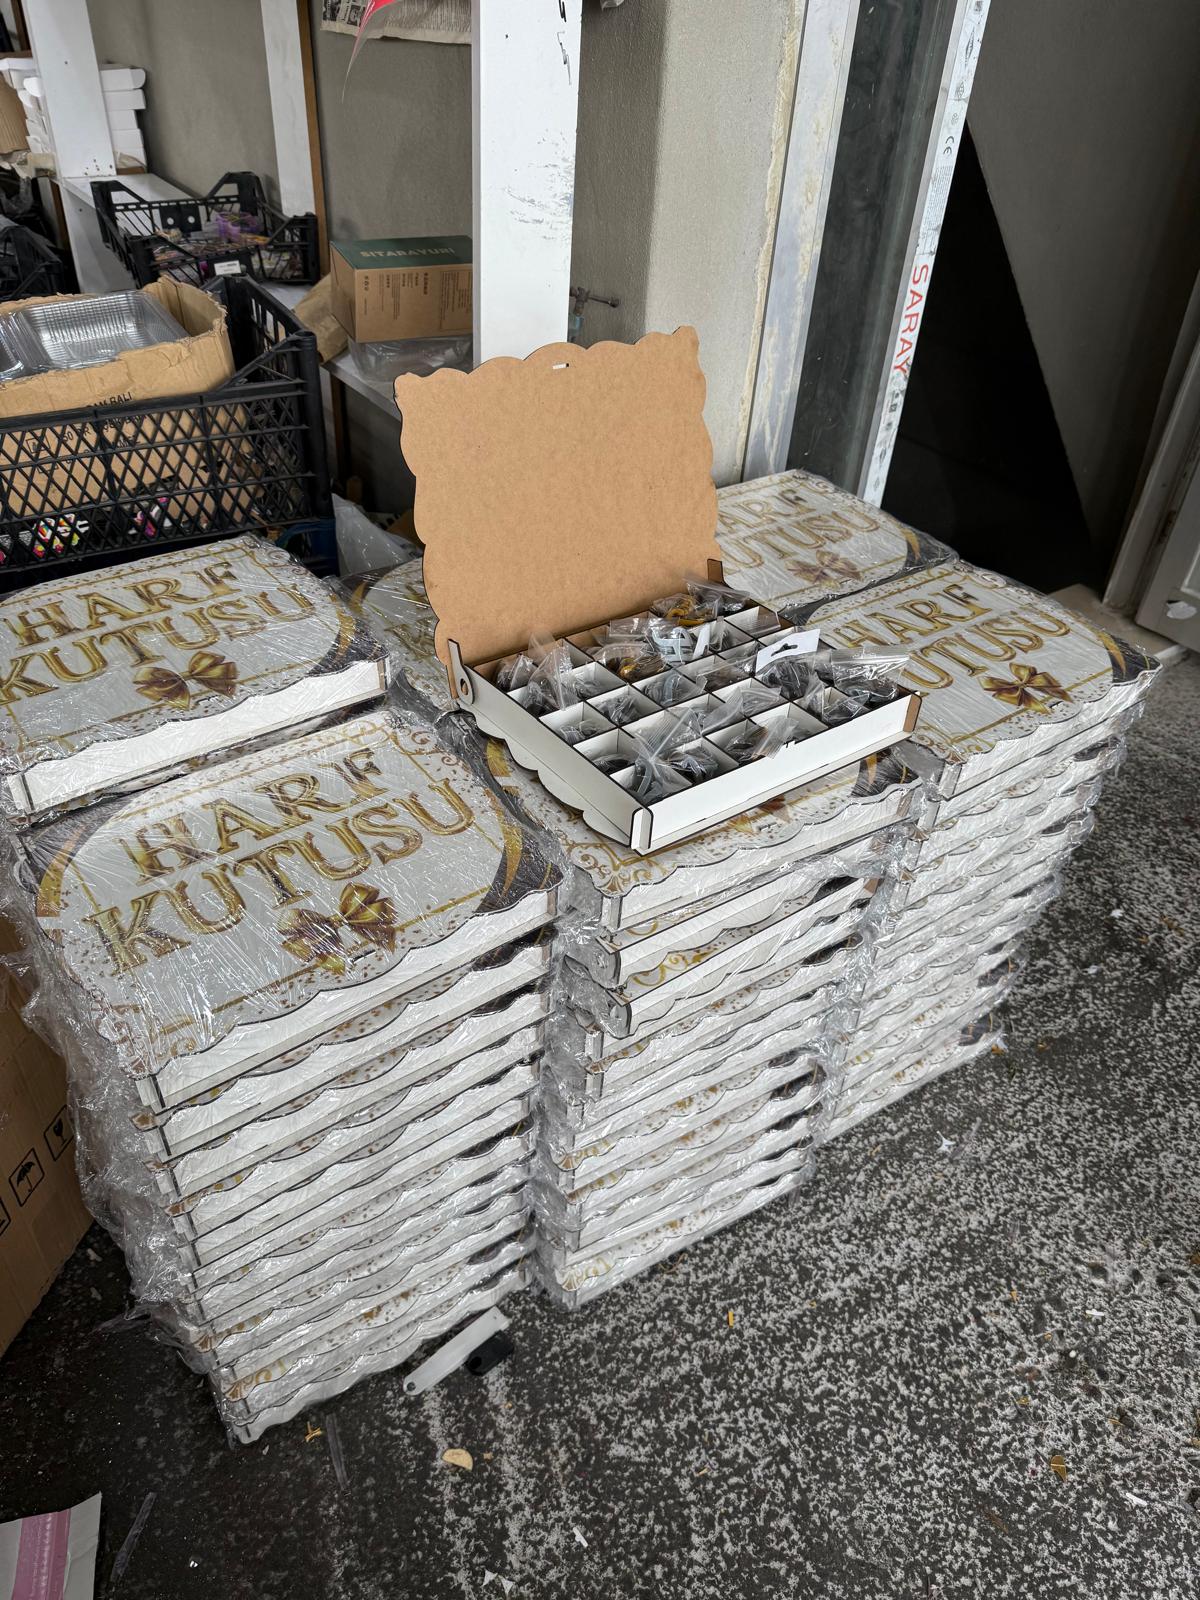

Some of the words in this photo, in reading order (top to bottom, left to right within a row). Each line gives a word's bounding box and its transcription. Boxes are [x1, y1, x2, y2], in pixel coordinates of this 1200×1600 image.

[892, 264, 929, 374] SARAY
[718, 488, 816, 534] ARF
[720, 505, 881, 576] UTUSU
[0, 583, 318, 704] KUTUSU
[4, 561, 242, 648] HARF
[825, 583, 992, 648] HARF
[901, 604, 1071, 698] UTUSU
[118, 748, 390, 886] HARF
[82, 777, 474, 977] KUTUSU
